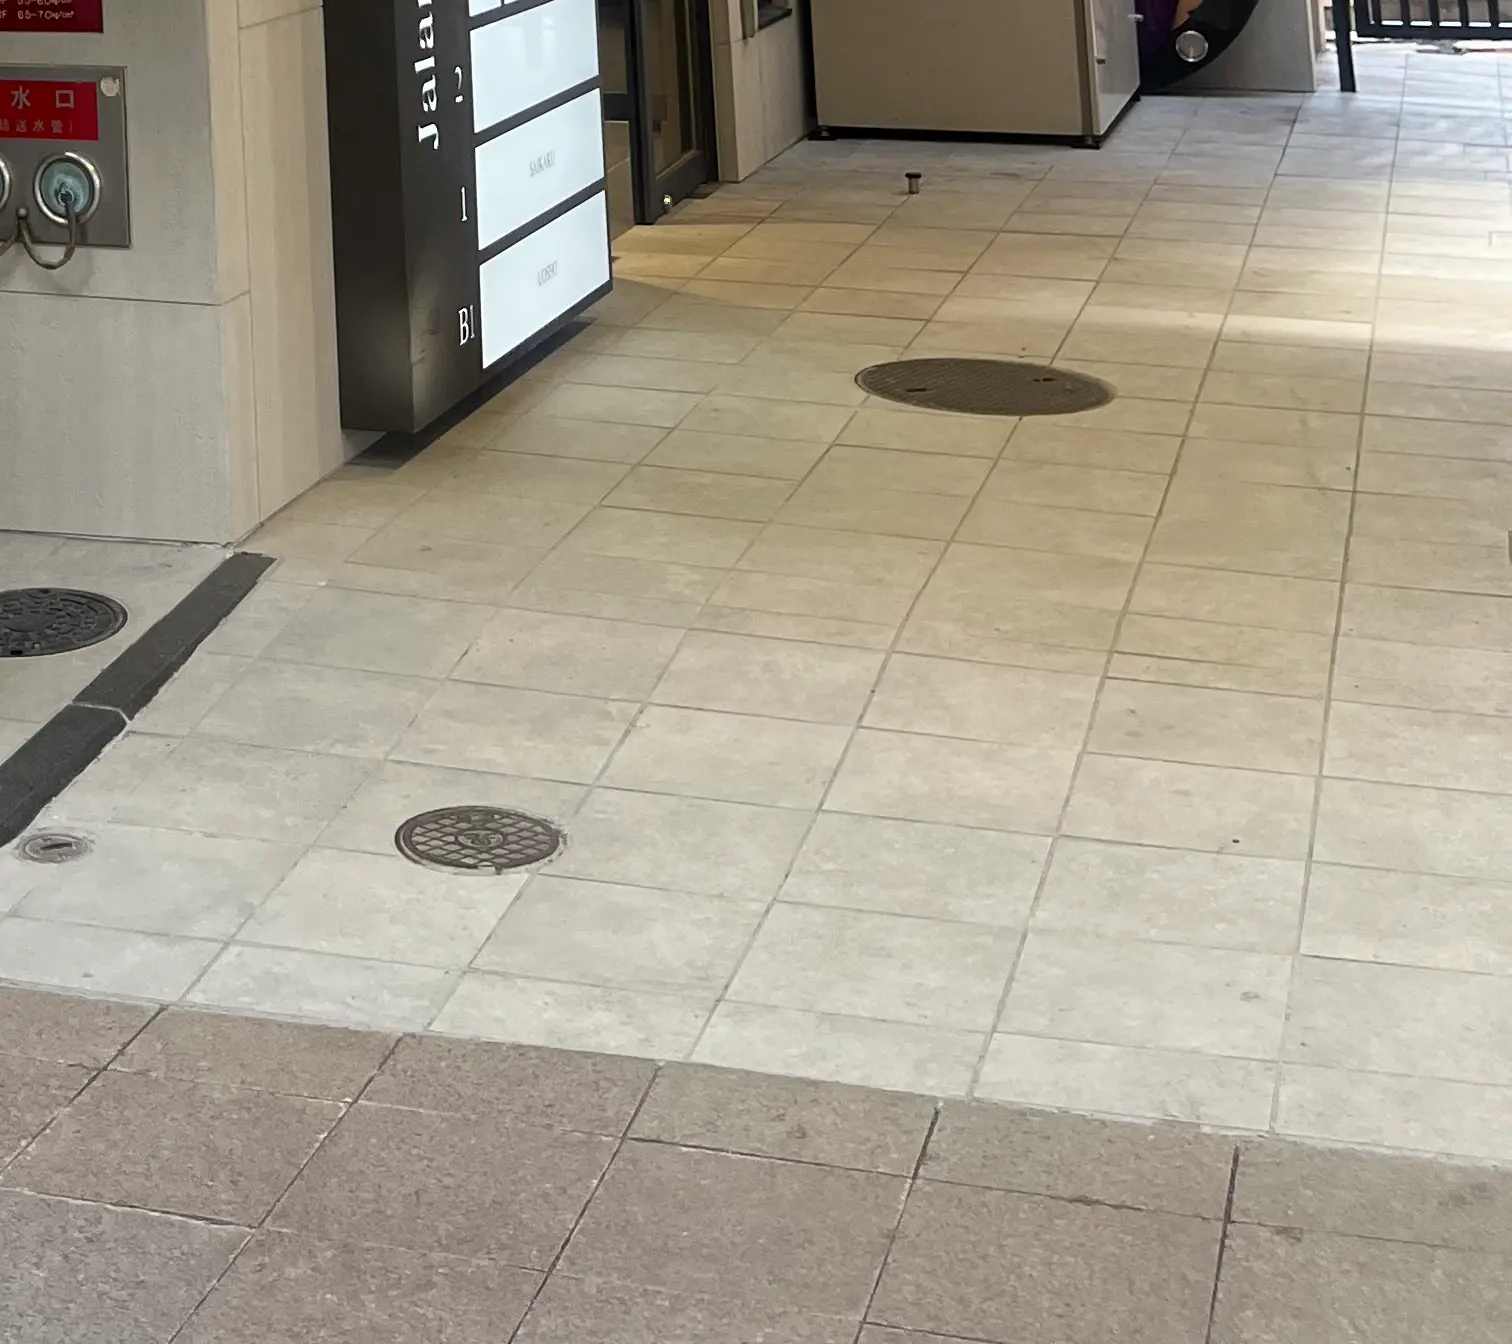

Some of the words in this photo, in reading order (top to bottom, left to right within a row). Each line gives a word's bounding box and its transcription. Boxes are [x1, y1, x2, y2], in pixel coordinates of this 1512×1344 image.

[455, 65, 464, 103] 2
[460, 186, 468, 222] 1
[458, 304, 475, 346] B1
